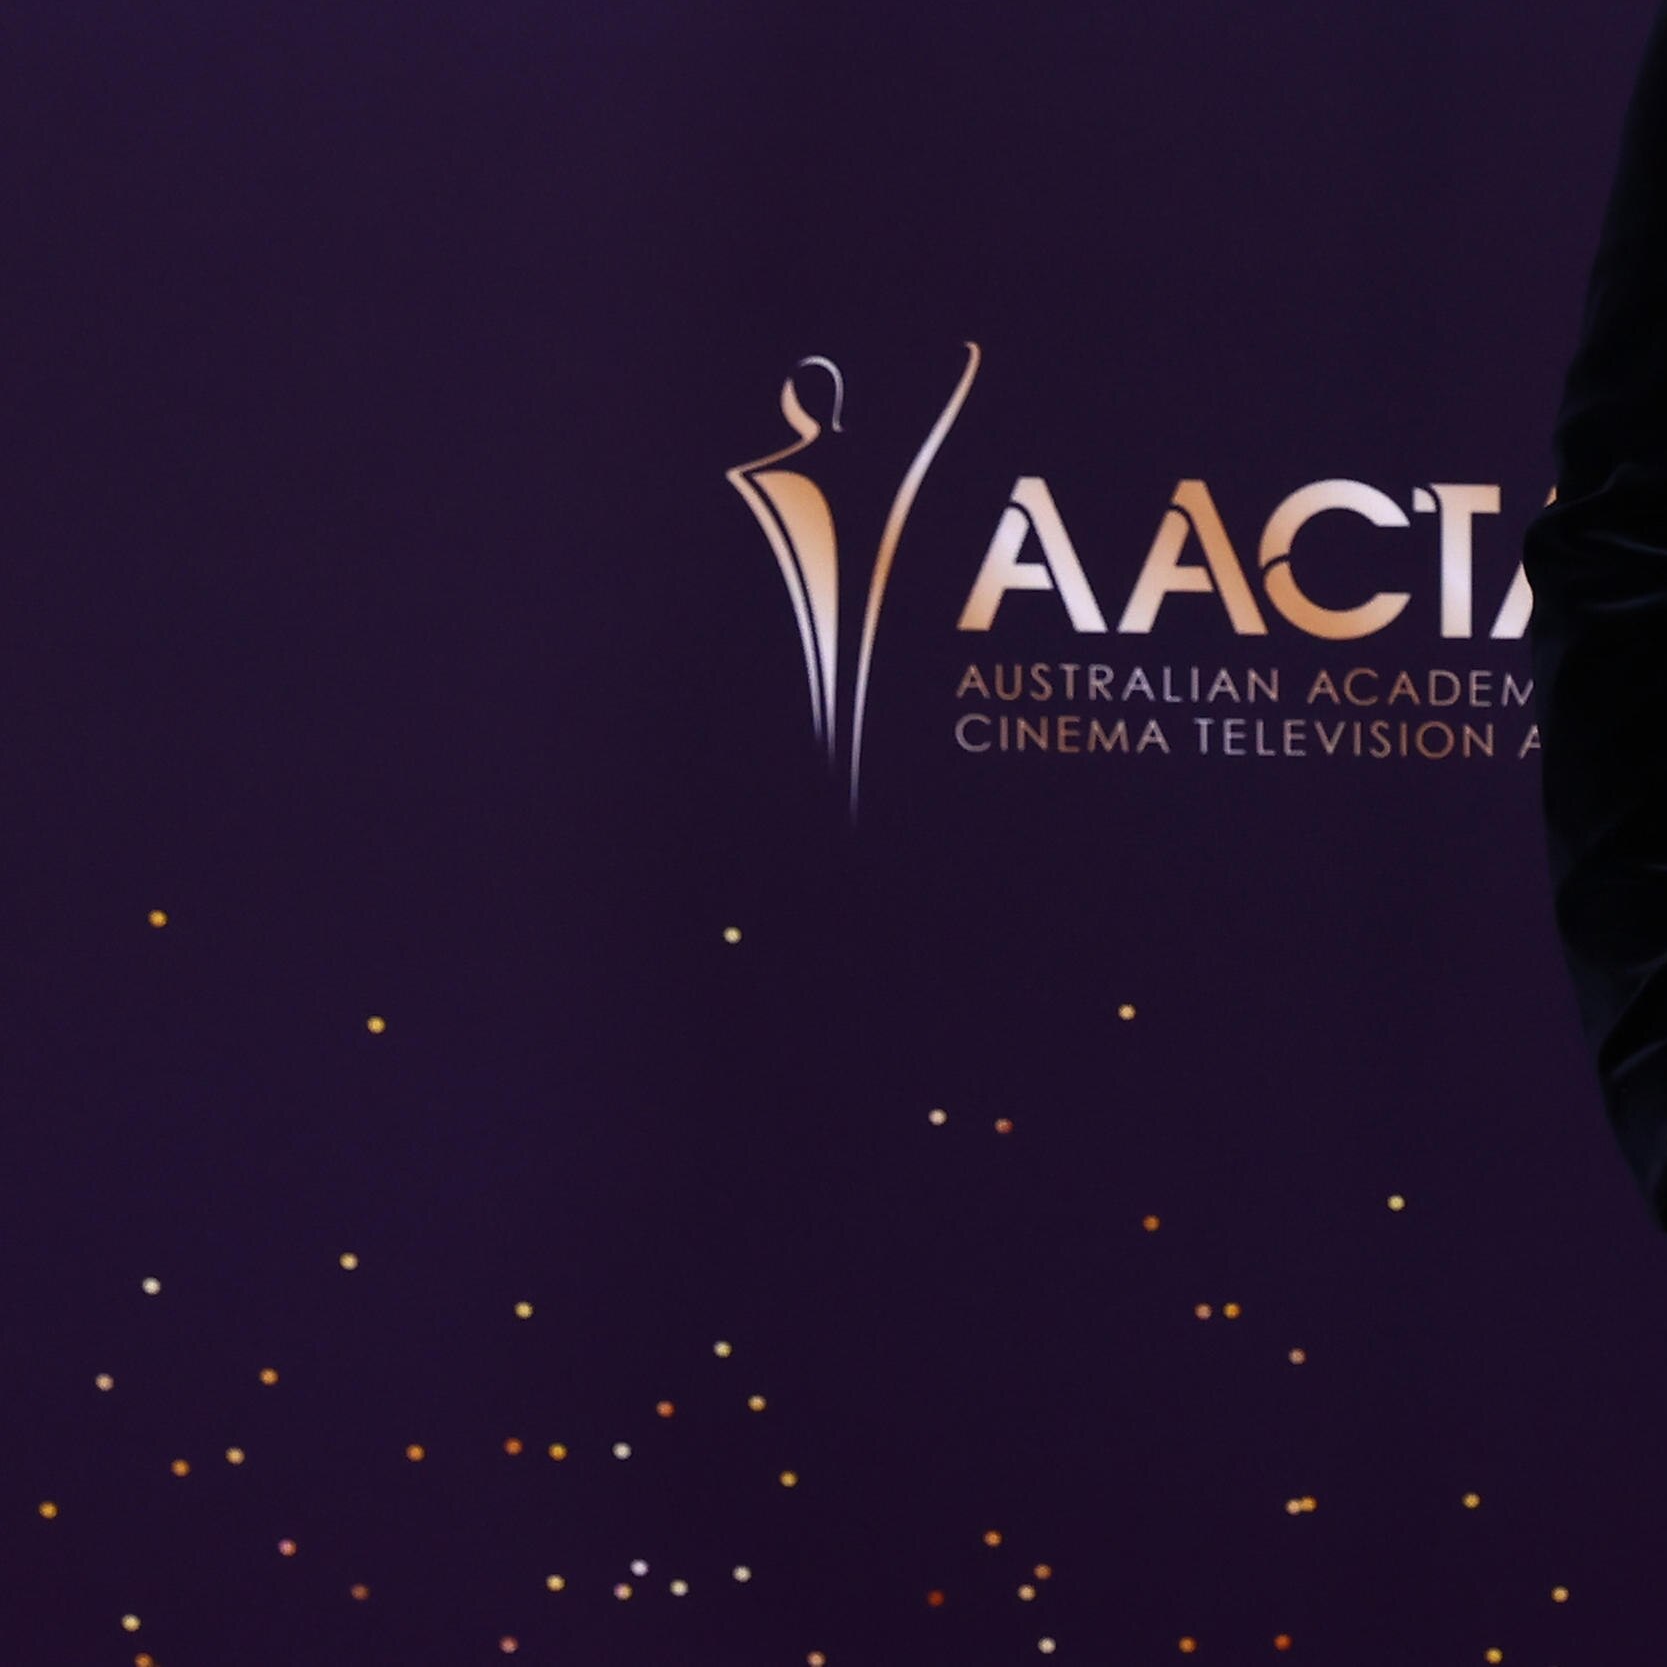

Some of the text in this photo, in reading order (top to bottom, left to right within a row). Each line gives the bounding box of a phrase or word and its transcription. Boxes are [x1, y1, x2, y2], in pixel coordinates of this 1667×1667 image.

[956, 662, 1535, 709] AUSTRALIAN ACADEM
[953, 712, 1171, 755] CINEMA
[1193, 716, 1495, 759] TELEVISION
